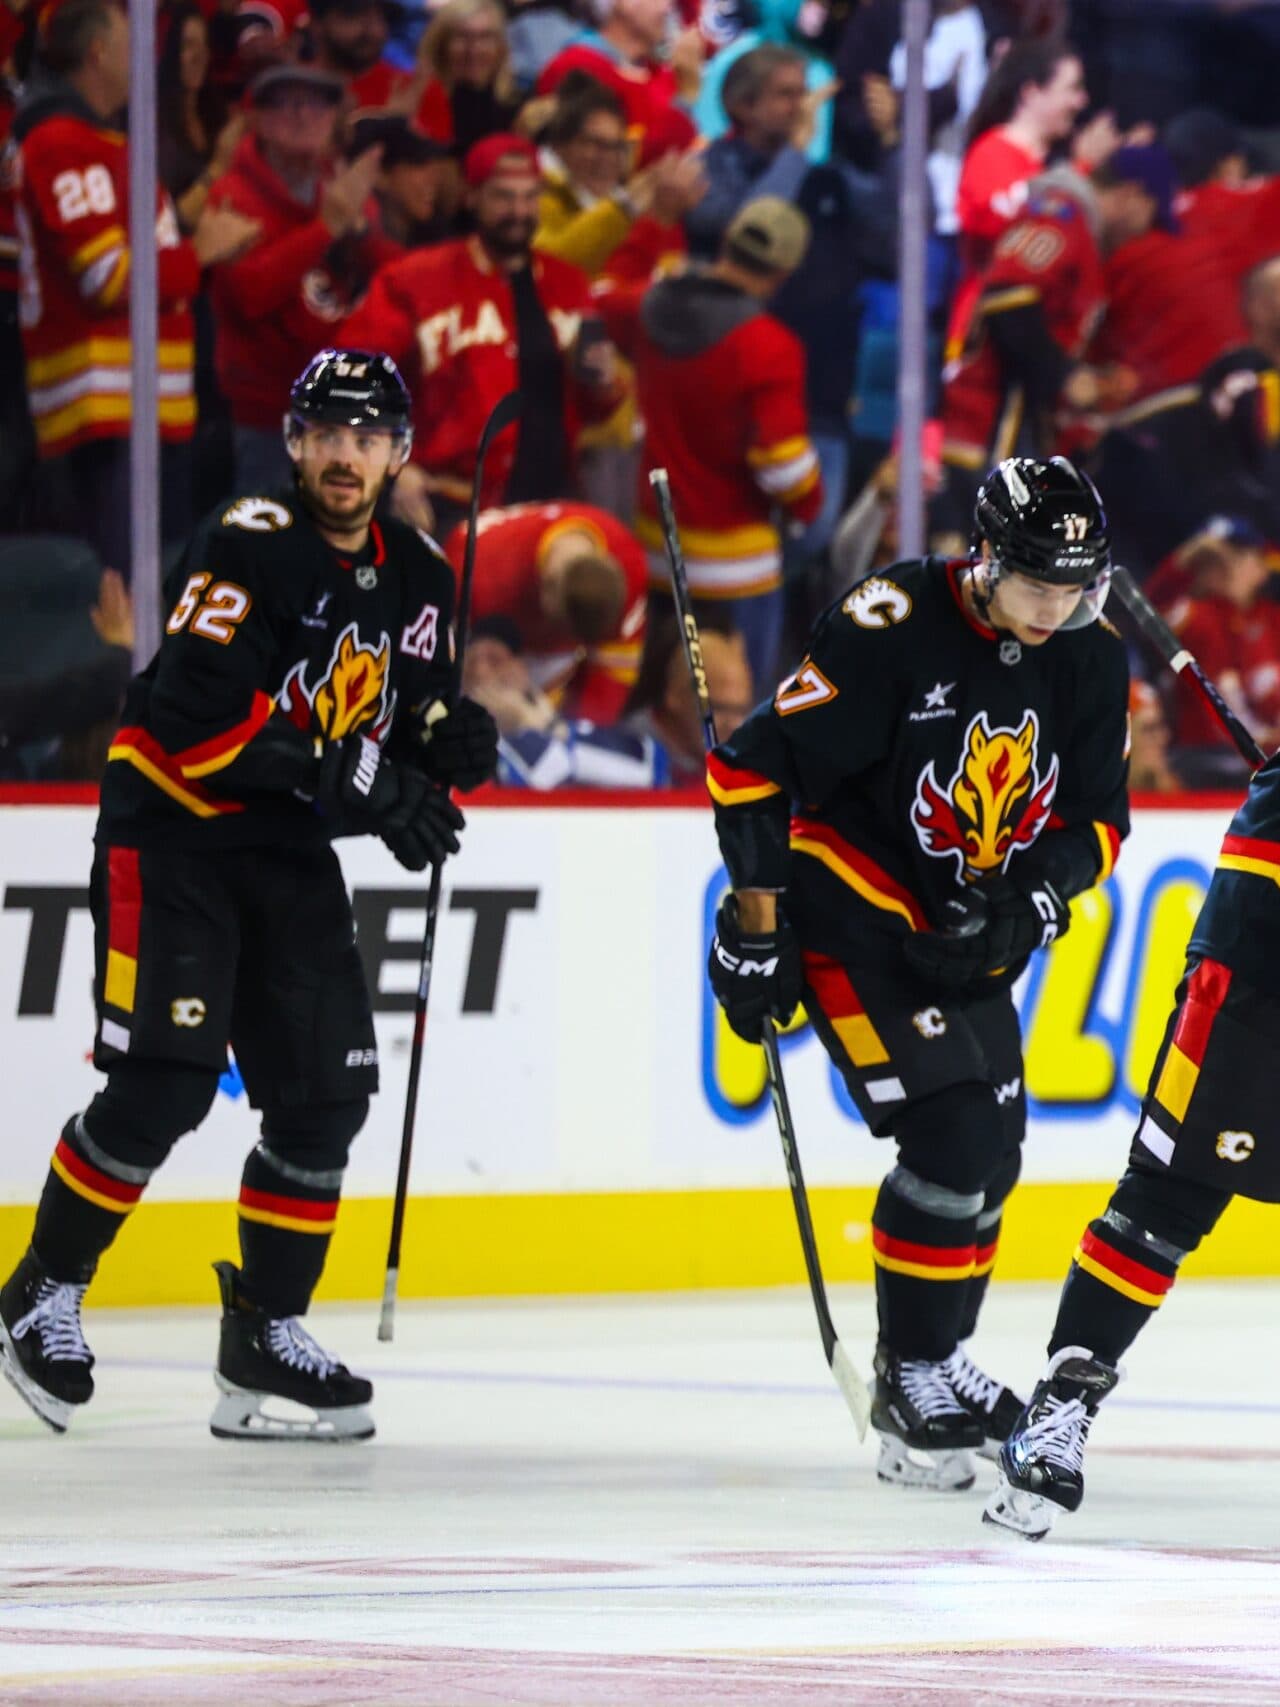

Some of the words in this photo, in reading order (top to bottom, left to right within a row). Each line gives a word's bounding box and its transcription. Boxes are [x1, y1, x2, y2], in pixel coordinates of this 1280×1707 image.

[1063, 516, 1088, 542] 17
[166, 571, 252, 646] 52
[401, 604, 440, 661] A
[684, 613, 709, 698] CCM
[1031, 890, 1057, 948] CC
[712, 935, 779, 977] CM
